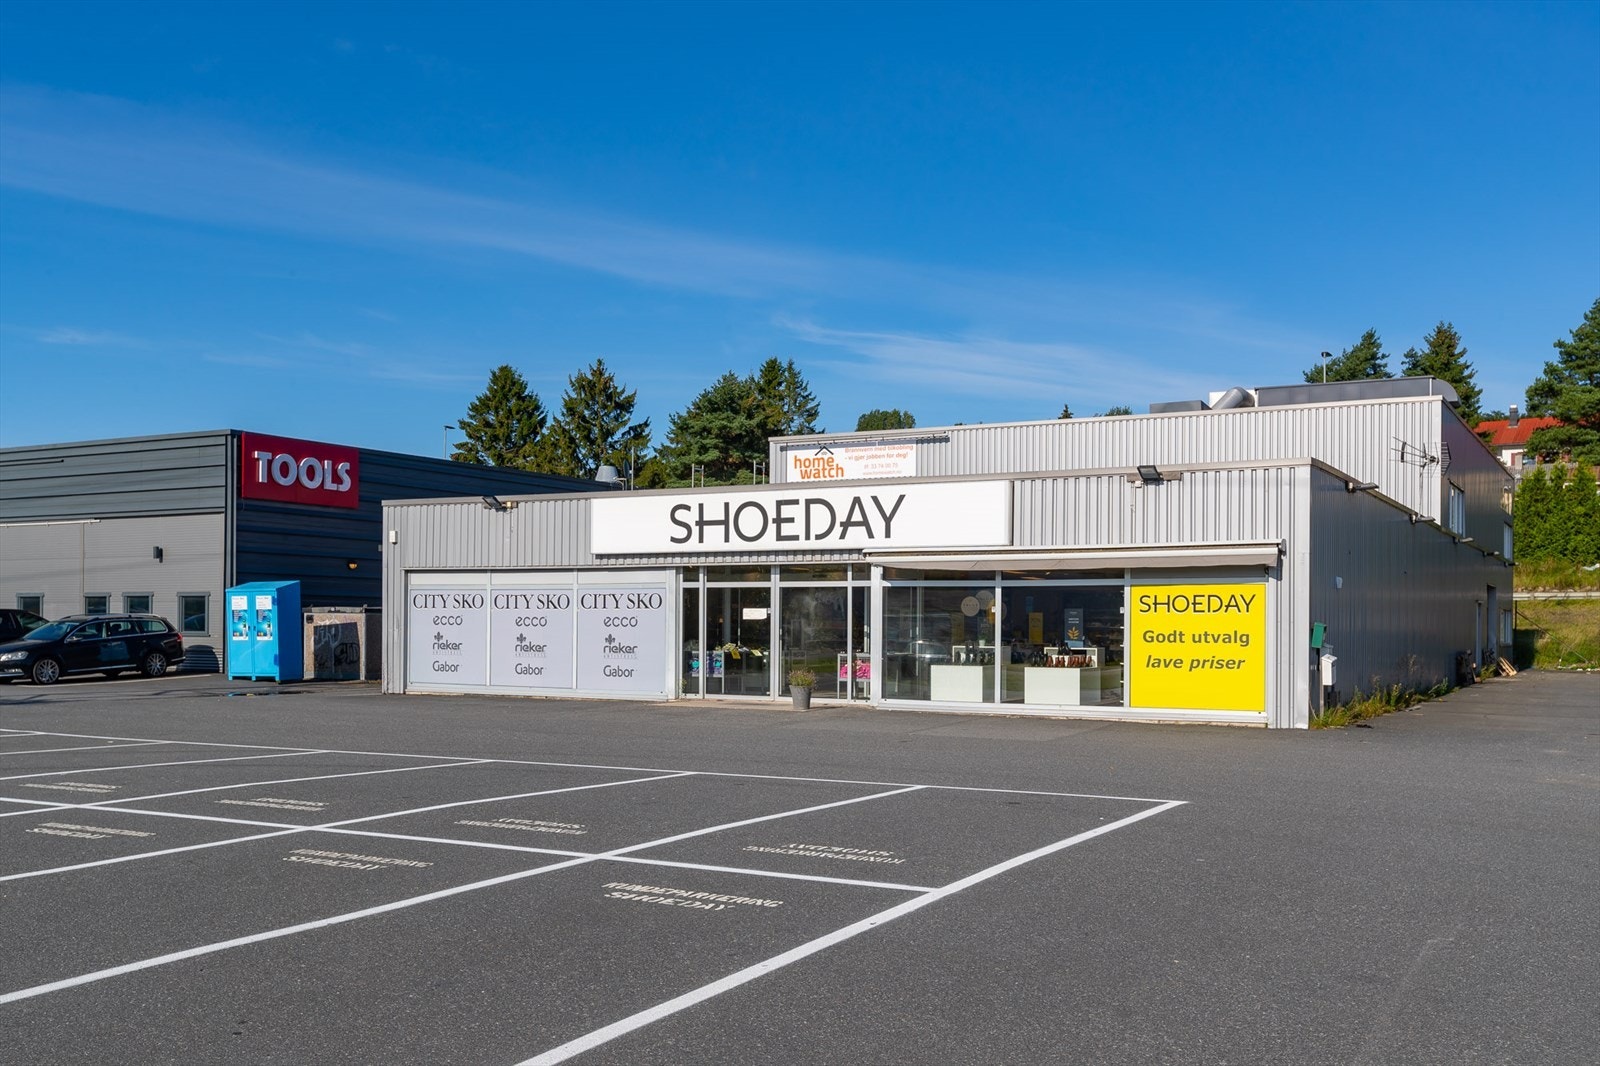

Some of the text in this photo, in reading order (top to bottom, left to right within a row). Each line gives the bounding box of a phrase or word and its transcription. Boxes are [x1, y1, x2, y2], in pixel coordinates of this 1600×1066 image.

[793, 455, 835, 469] home
[253, 451, 352, 492] TOOLS
[800, 464, 844, 480] watch
[669, 493, 906, 544] SHOEDAY
[413, 594, 484, 609] CITY SKO
[494, 593, 570, 610] CITY SKO
[581, 593, 663, 610] CITY SKO
[1139, 594, 1256, 613] SHOEDAY
[432, 615, 463, 626] ecco
[515, 616, 548, 628] ecco
[604, 616, 639, 628] ecco
[432, 640, 463, 651] rieker
[1142, 629, 1250, 648] Godt utvalg
[515, 641, 548, 653] rieker
[604, 642, 639, 654] rieker
[432, 661, 460, 673] Gabor
[515, 663, 544, 676] Gabor
[1146, 654, 1246, 672] lave priser
[603, 665, 635, 678] Gabor
[601, 882, 784, 908] KUNDEPARKERING
[604, 892, 735, 911] SHOEDAY
